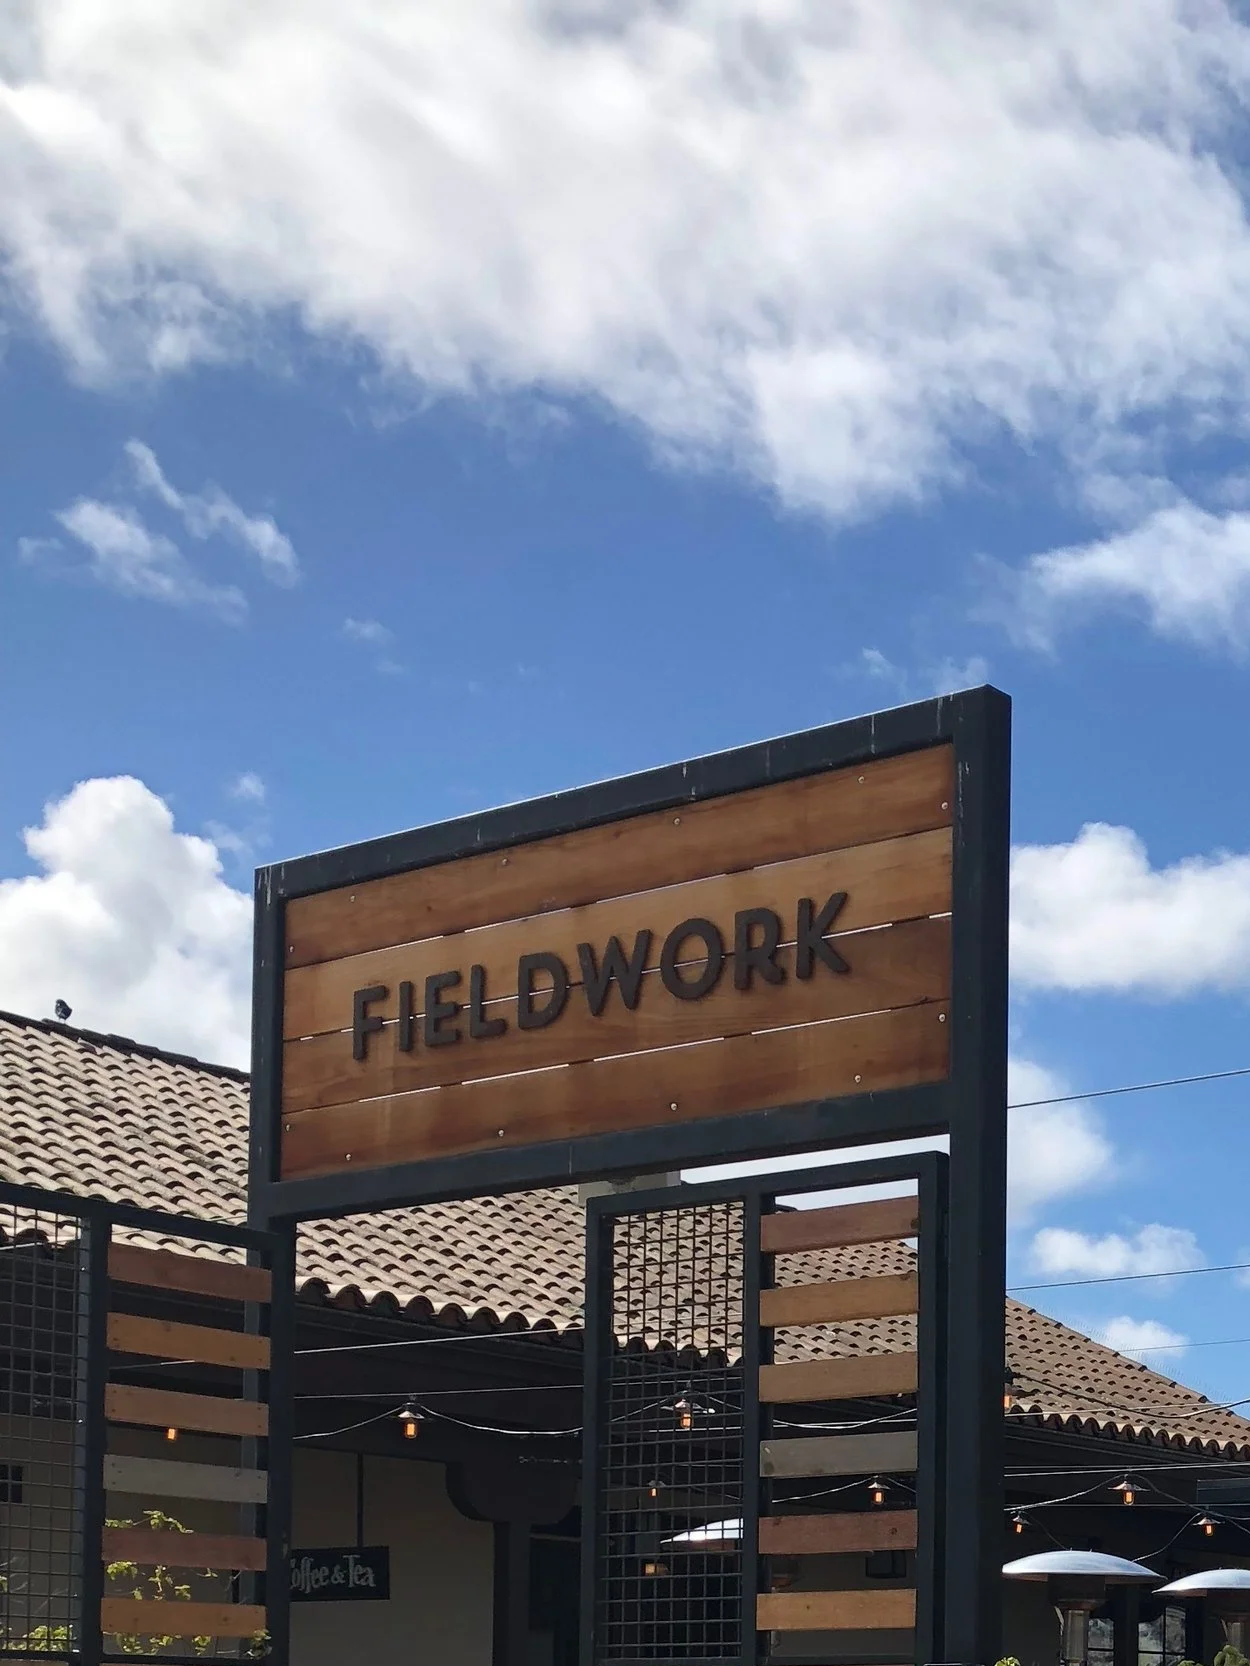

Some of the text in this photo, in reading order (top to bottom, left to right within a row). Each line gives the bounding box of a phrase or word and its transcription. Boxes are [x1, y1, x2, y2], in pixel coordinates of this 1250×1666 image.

[352, 891, 850, 1061] FIELDWORK
[331, 1564, 345, 1584] &
[343, 1554, 376, 1588] Tea
